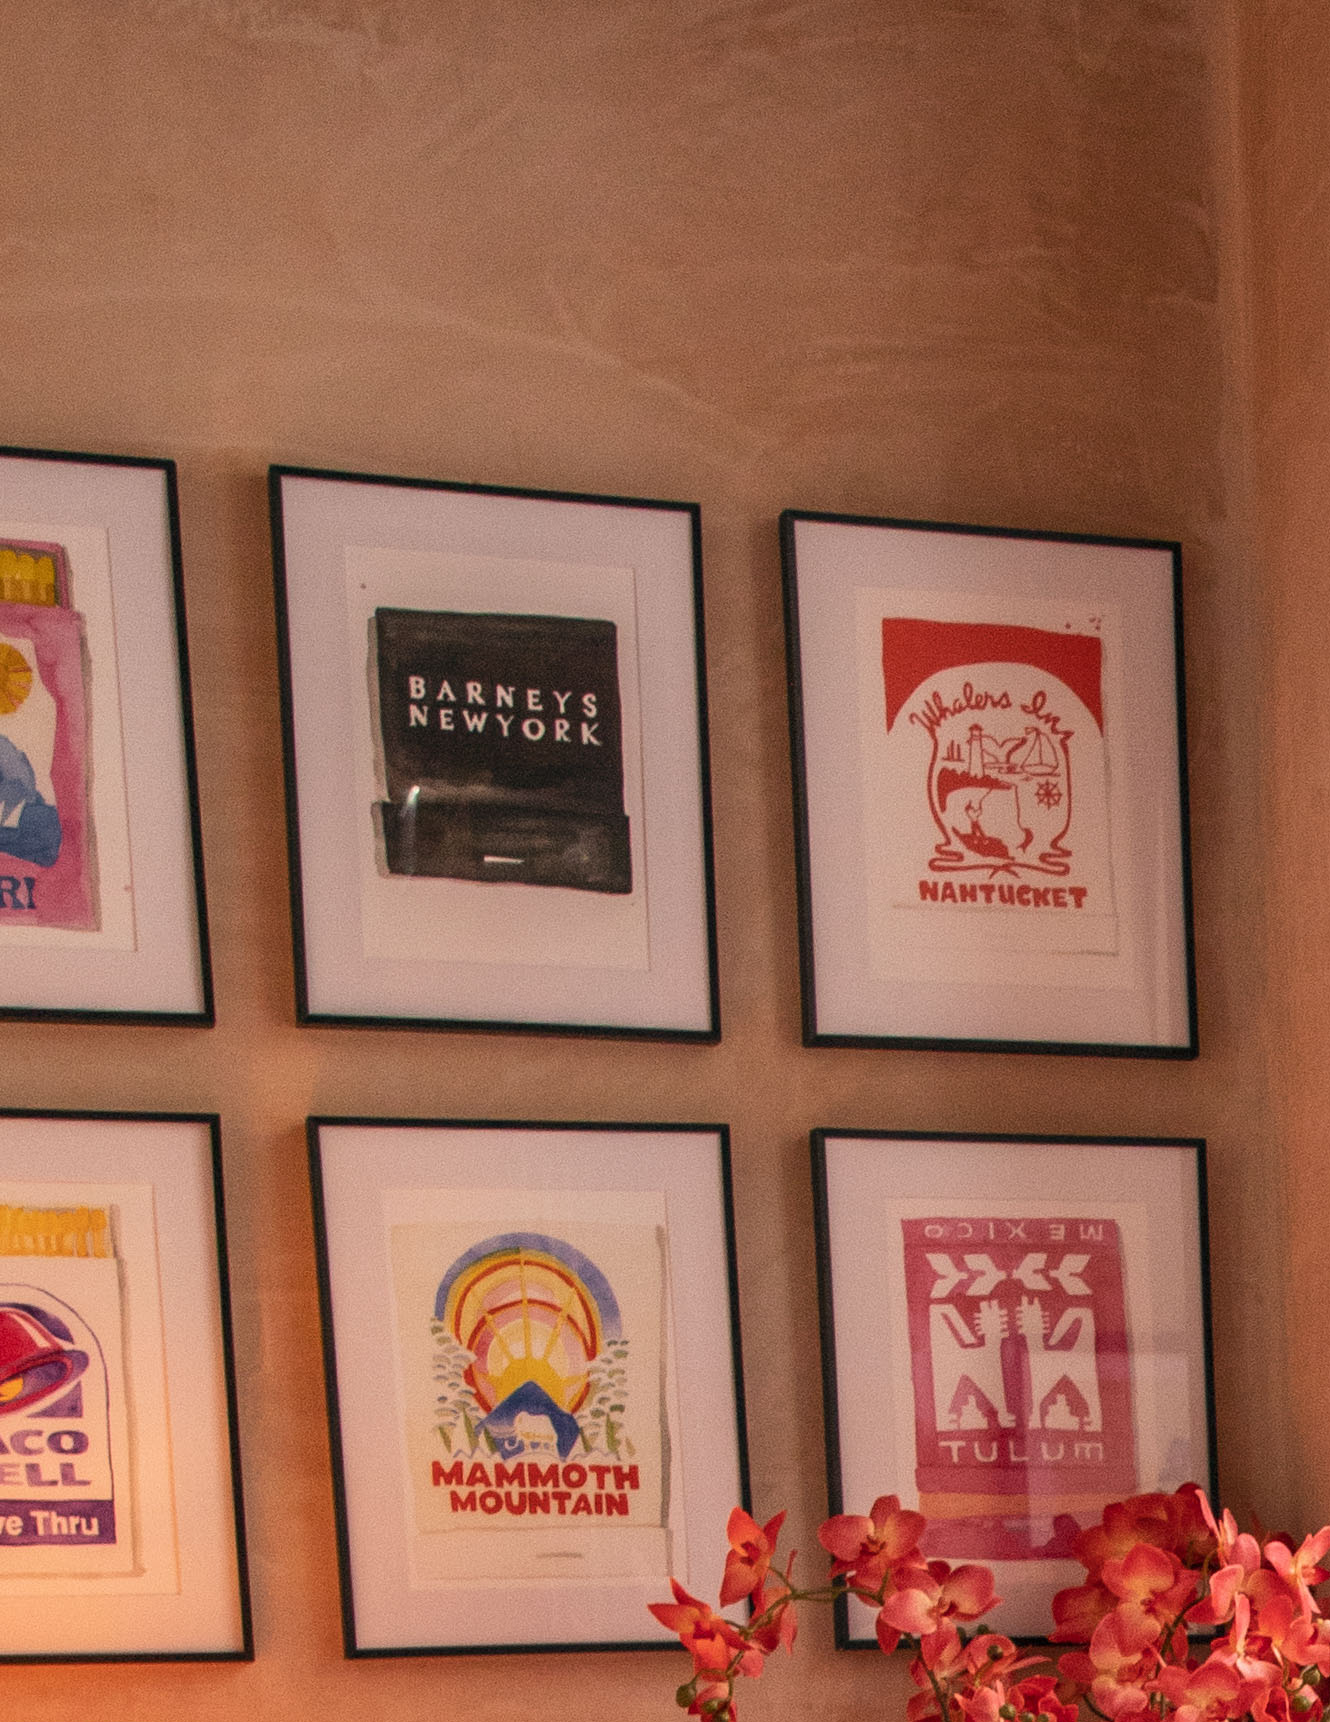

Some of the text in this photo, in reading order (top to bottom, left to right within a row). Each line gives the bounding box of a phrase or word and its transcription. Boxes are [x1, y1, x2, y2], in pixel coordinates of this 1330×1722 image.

[409, 675, 598, 718] BARNEYS
[908, 682, 1012, 728] Whalers
[918, 879, 1088, 909] NANTUCKET
[923, 1221, 1103, 1241] MEXICO
[938, 1439, 1104, 1463] TULUM
[431, 1460, 640, 1490] MAMMOTH
[449, 1490, 630, 1517] MOUNTAIN
[29, 1509, 100, 1537] Thru
